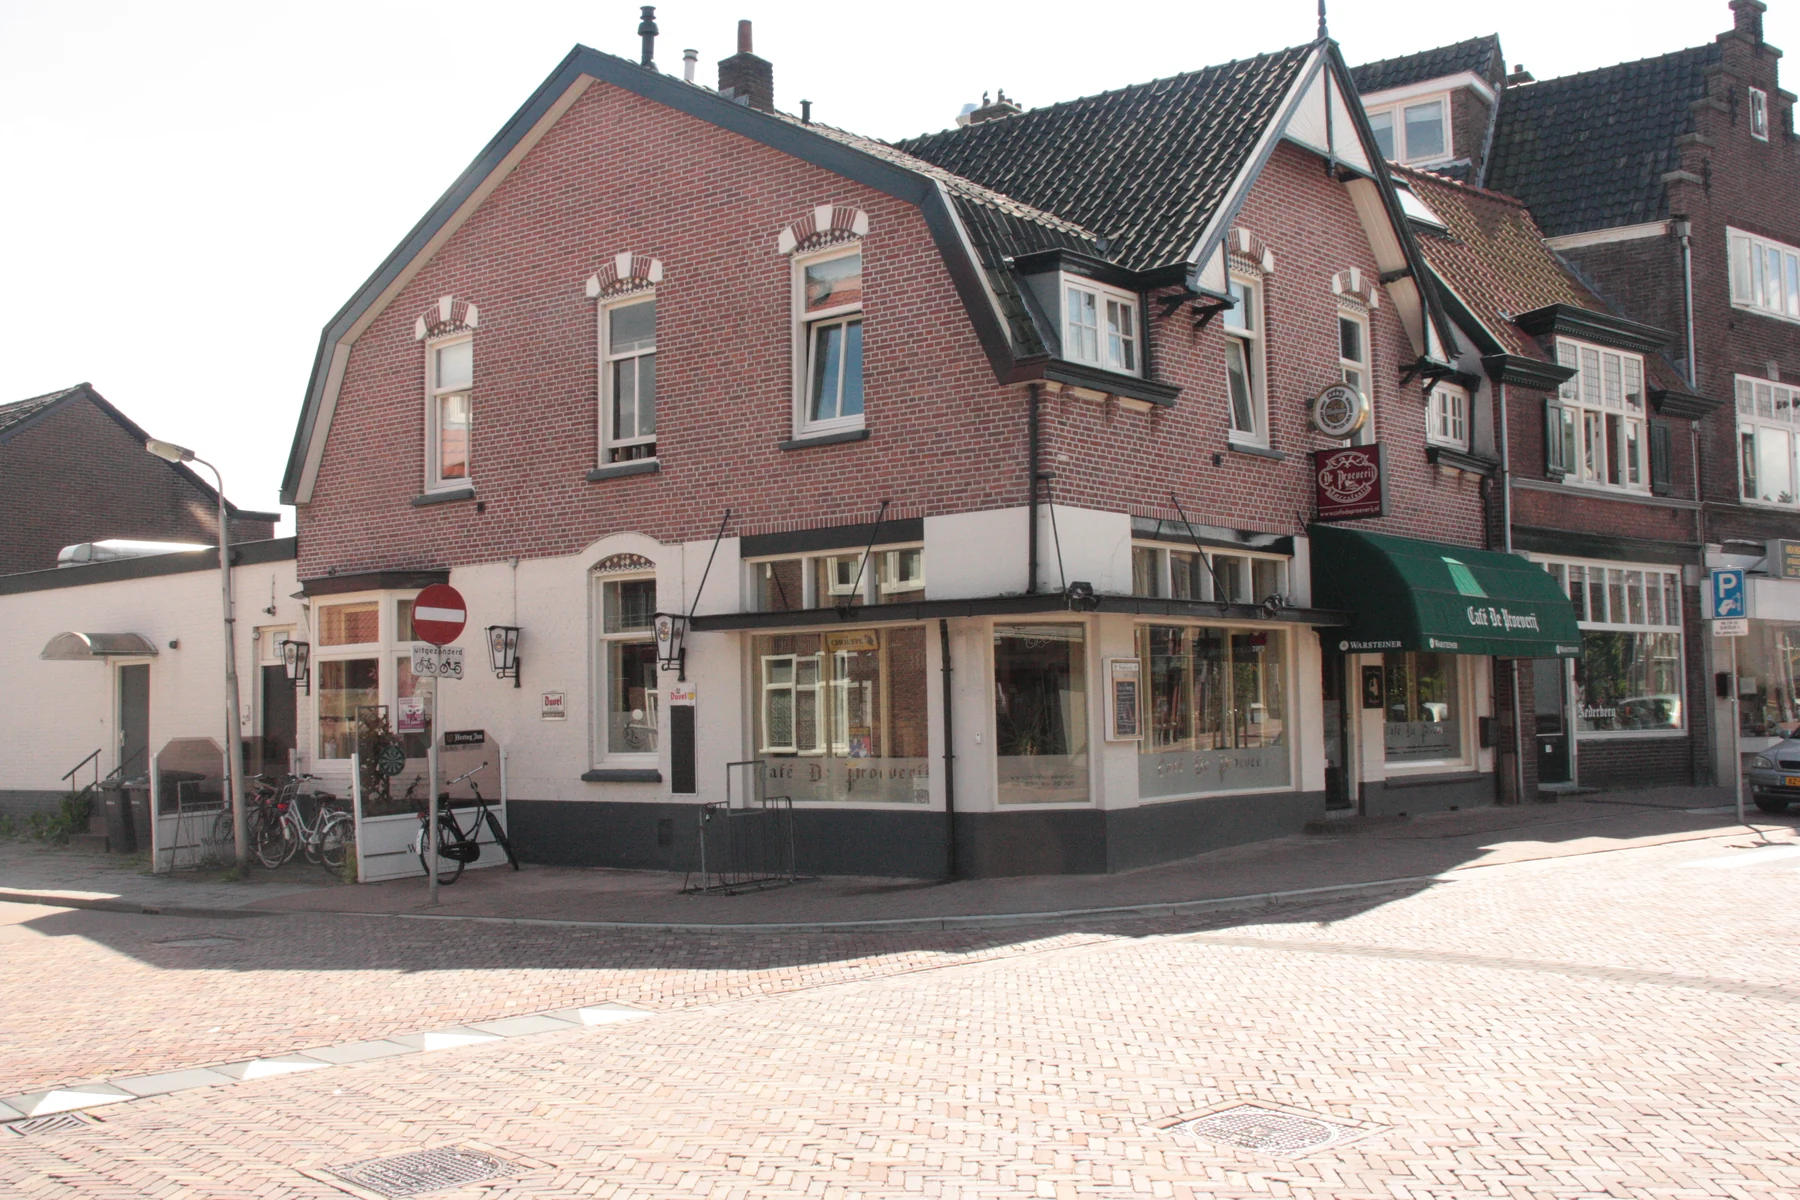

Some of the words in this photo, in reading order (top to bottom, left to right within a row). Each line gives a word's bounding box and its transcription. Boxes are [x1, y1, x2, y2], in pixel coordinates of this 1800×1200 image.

[1323, 471, 1334, 486] De
[1337, 467, 1374, 490] Proeverij
[1718, 573, 1737, 598] P
[1467, 606, 1489, 626] Café
[1488, 607, 1502, 627] De
[1501, 608, 1540, 633] Proeverij
[1350, 640, 1402, 649] WARSTEINER
[414, 648, 463, 656] uitgezonderd
[545, 695, 562, 706] Duvel
[670, 692, 687, 700] Duvel
